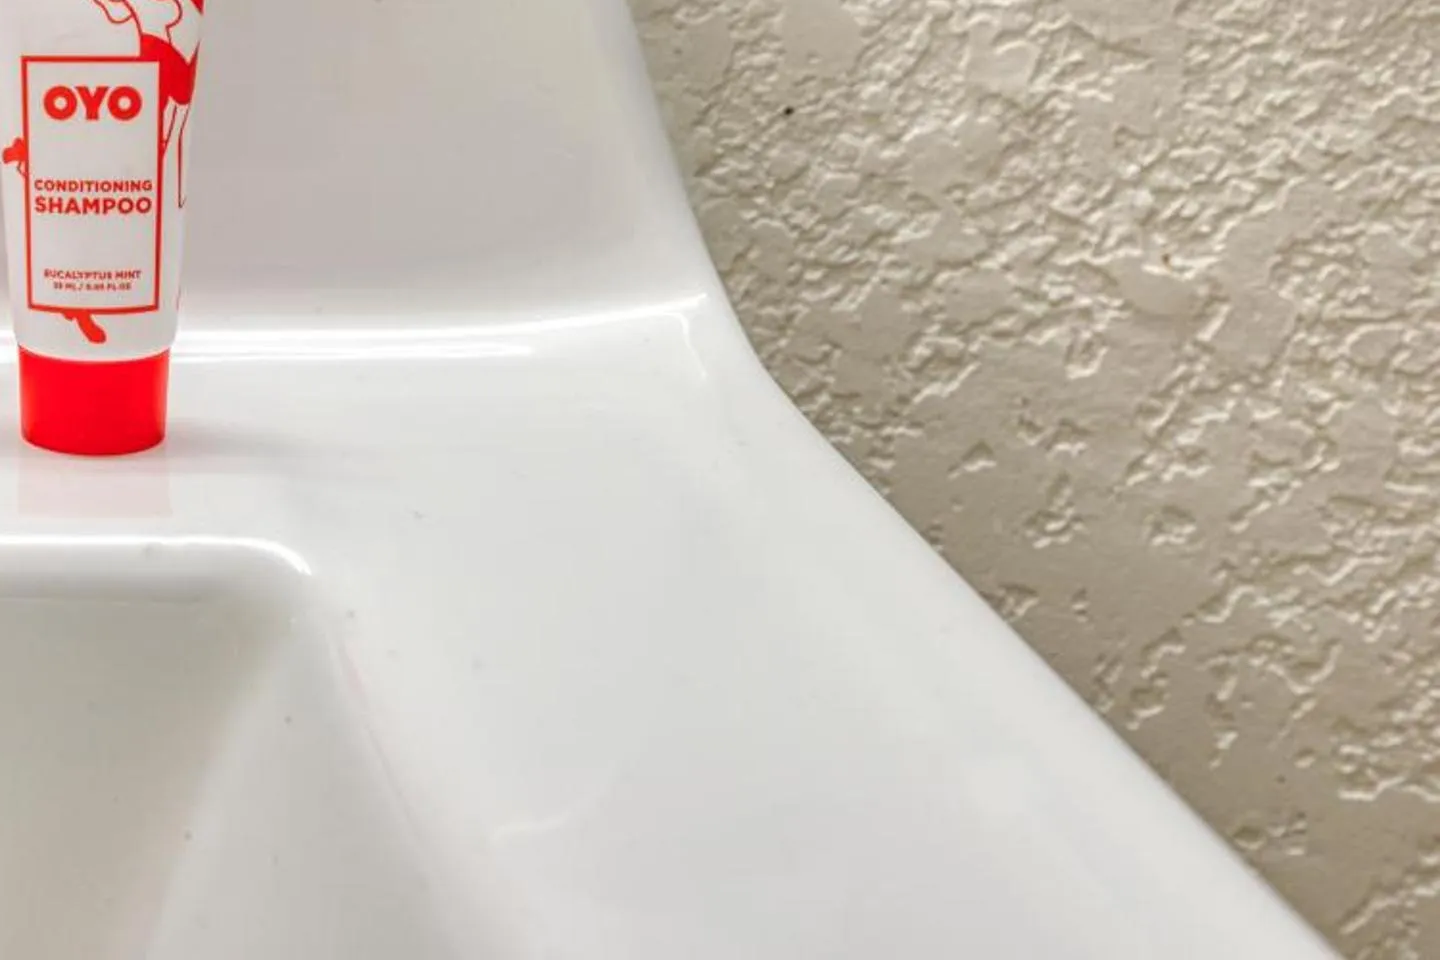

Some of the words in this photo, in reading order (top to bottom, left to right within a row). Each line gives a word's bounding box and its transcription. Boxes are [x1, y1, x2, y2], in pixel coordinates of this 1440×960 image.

[43, 85, 143, 121] OYO
[34, 179, 153, 192] CONDITIONING
[34, 197, 153, 215] SHAMPOO
[43, 269, 113, 280] EUCALYPTUS
[114, 269, 142, 280] MINT
